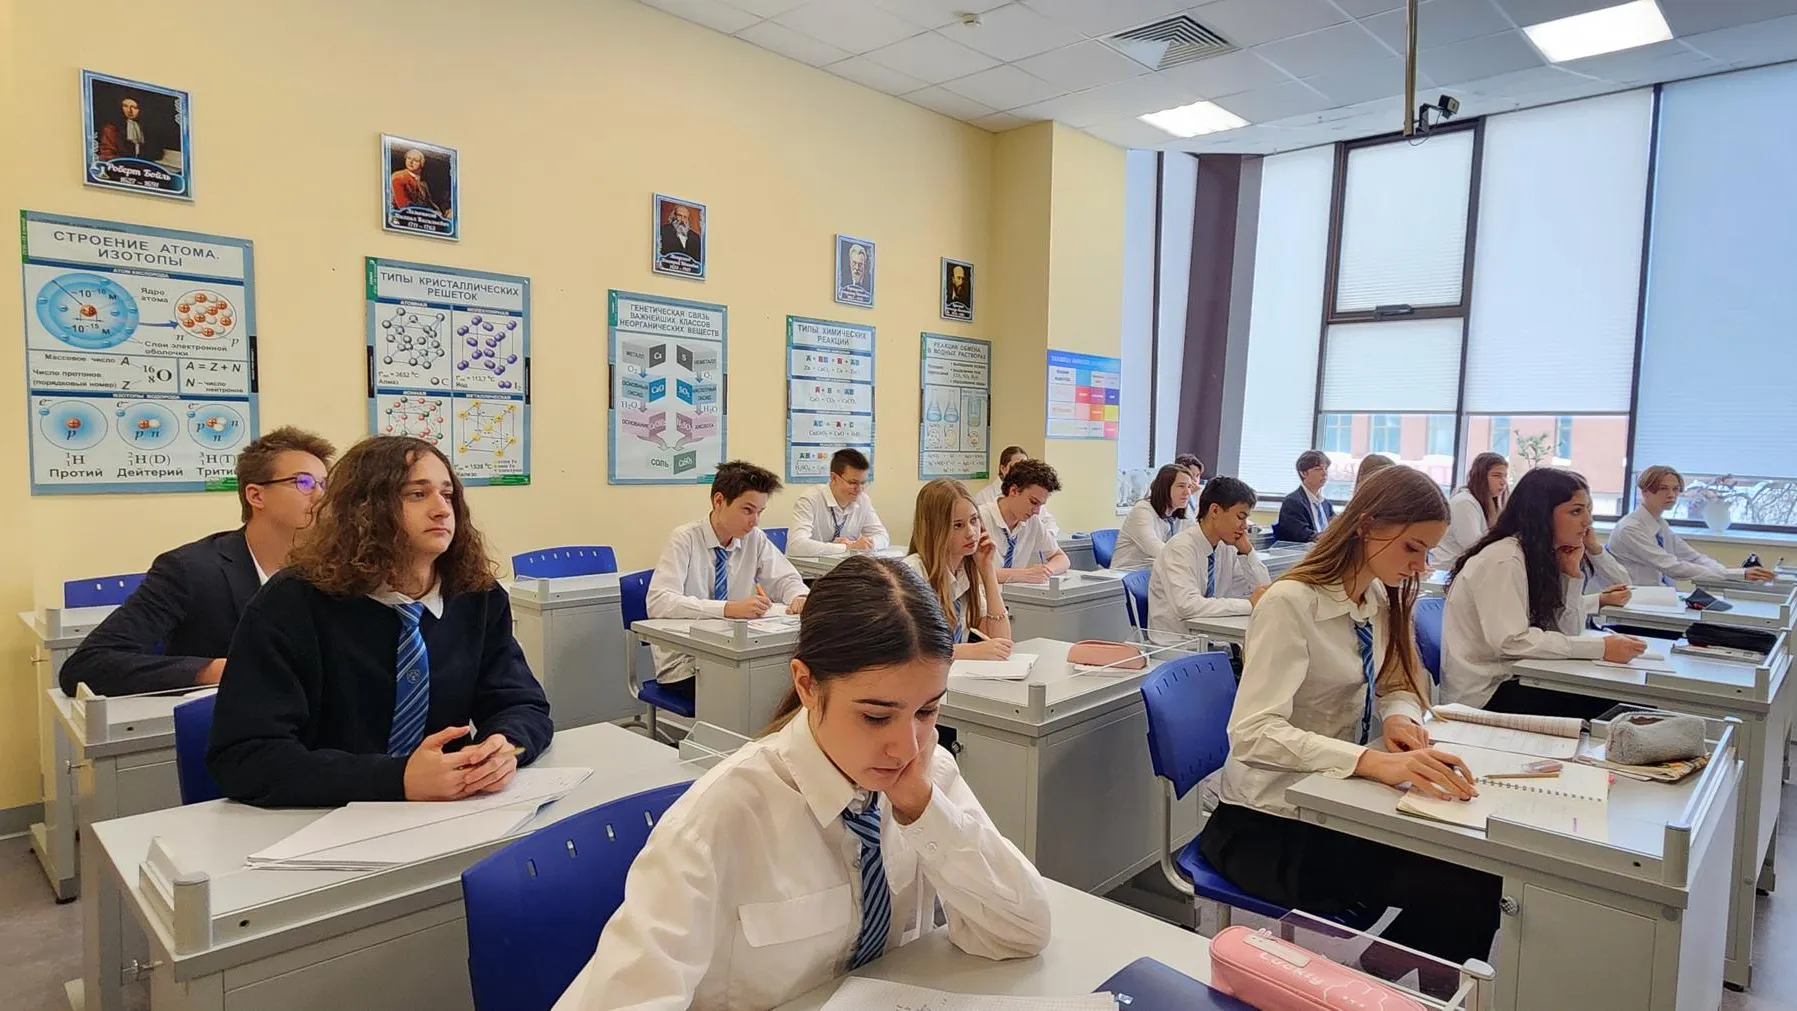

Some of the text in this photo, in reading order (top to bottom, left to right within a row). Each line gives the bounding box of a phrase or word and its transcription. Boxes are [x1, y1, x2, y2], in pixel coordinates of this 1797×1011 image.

[53, 231, 220, 260] СТРОЕНИЕ АТОМА.
[98, 249, 182, 267] ИЗОТОПЫ
[380, 272, 413, 284] ТИПЫ
[419, 277, 519, 296] КРИСТАЛЛИЧЕСКИХ
[141, 288, 165, 296] Ядро
[427, 288, 478, 301] РЕШЕТОК
[630, 304, 710, 321] ГЕНЕТИЧЕСКАЯ СВЯЗЬ
[630, 312, 711, 328] ВАЖНЕЙШИХ КЛАССОВ
[619, 320, 720, 337] НЕОРГАНИЧЕСКИХ ВЕЩЕСТВ
[798, 324, 819, 333] ТИПЫ
[822, 328, 867, 340] ХИМИЧЕСКИХ
[818, 335, 850, 345] РЕАКЦИЙ
[145, 349, 189, 357] оболочки
[172, 343, 228, 352] электронной
[44, 354, 87, 362] Массовое
[120, 357, 130, 366] A
[185, 362, 195, 371] A
[210, 362, 219, 372] Z
[232, 364, 241, 373] N
[121, 381, 131, 390] Z
[185, 378, 196, 387] N
[650, 458, 670, 468] СОЛЬ
[49, 467, 237, 479] Протий Дейтерий Трити
